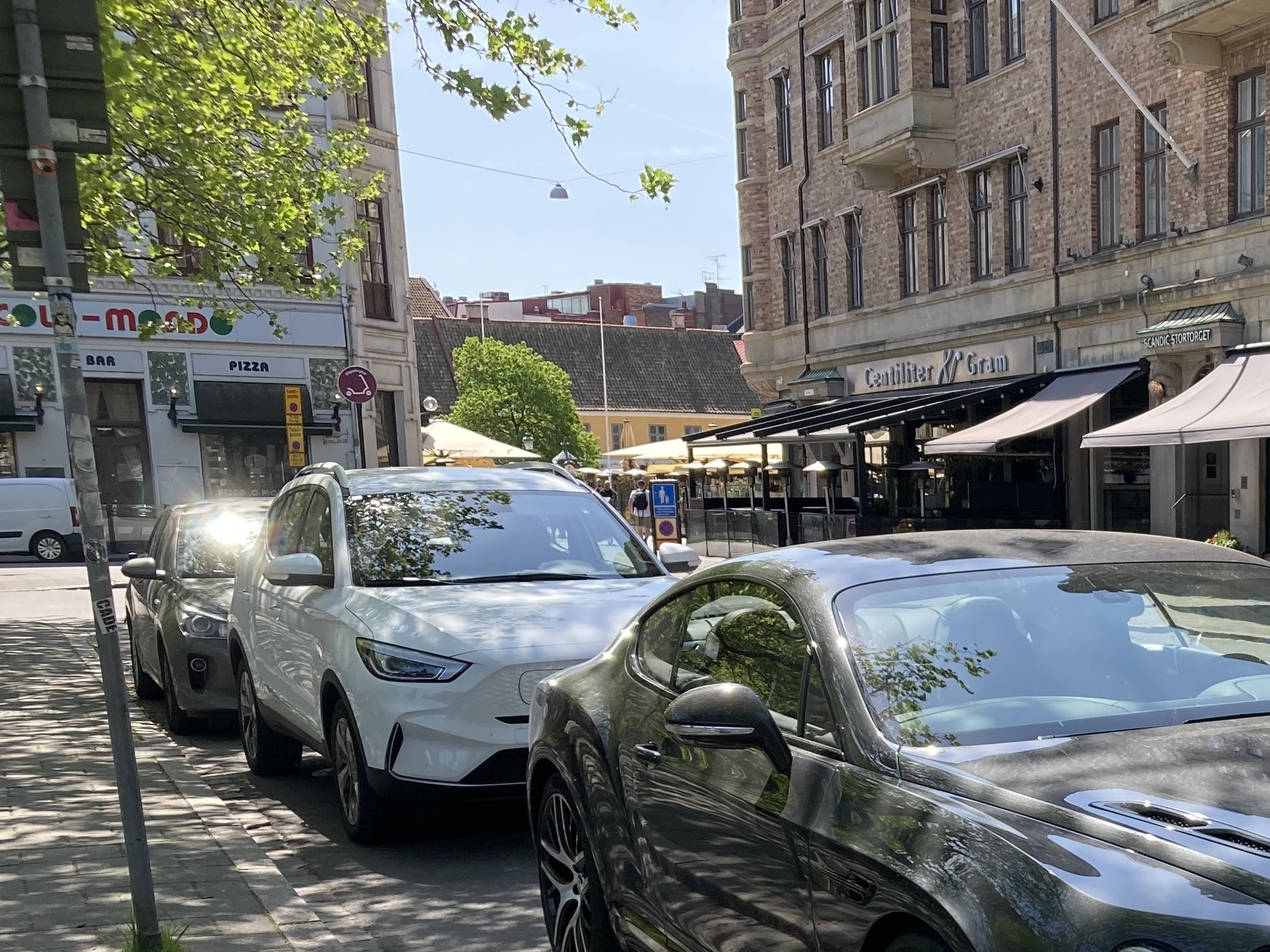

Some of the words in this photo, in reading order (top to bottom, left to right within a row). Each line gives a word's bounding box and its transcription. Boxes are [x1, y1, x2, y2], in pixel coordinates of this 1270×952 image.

[1143, 335, 1170, 349] SCANDIC
[1170, 328, 1211, 345] STORTORGET
[86, 354, 116, 367] BAR
[229, 360, 269, 372] PIZZA
[864, 361, 934, 388] Centiliter
[965, 351, 1008, 376] Gram
